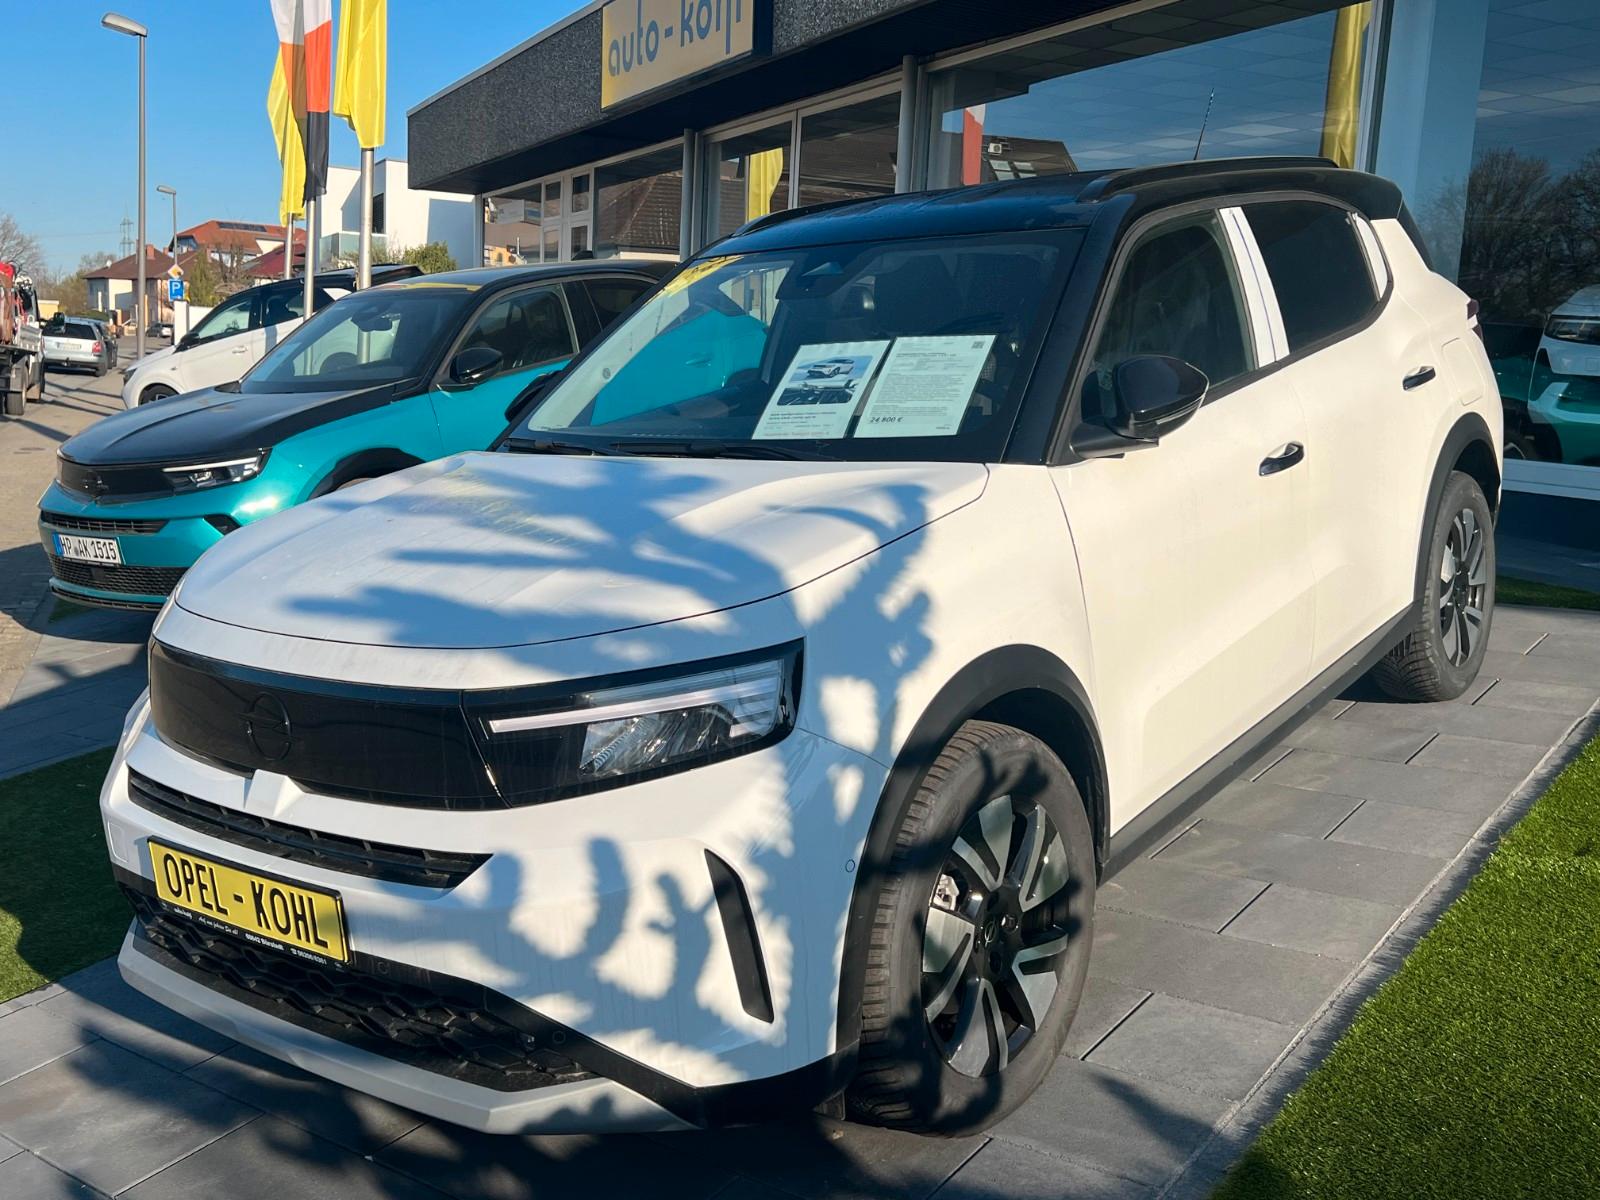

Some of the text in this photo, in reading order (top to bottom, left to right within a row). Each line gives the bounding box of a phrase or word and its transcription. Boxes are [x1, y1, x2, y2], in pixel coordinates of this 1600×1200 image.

[171, 282, 181, 294] P
[60, 536, 117, 560] HP AK 1515
